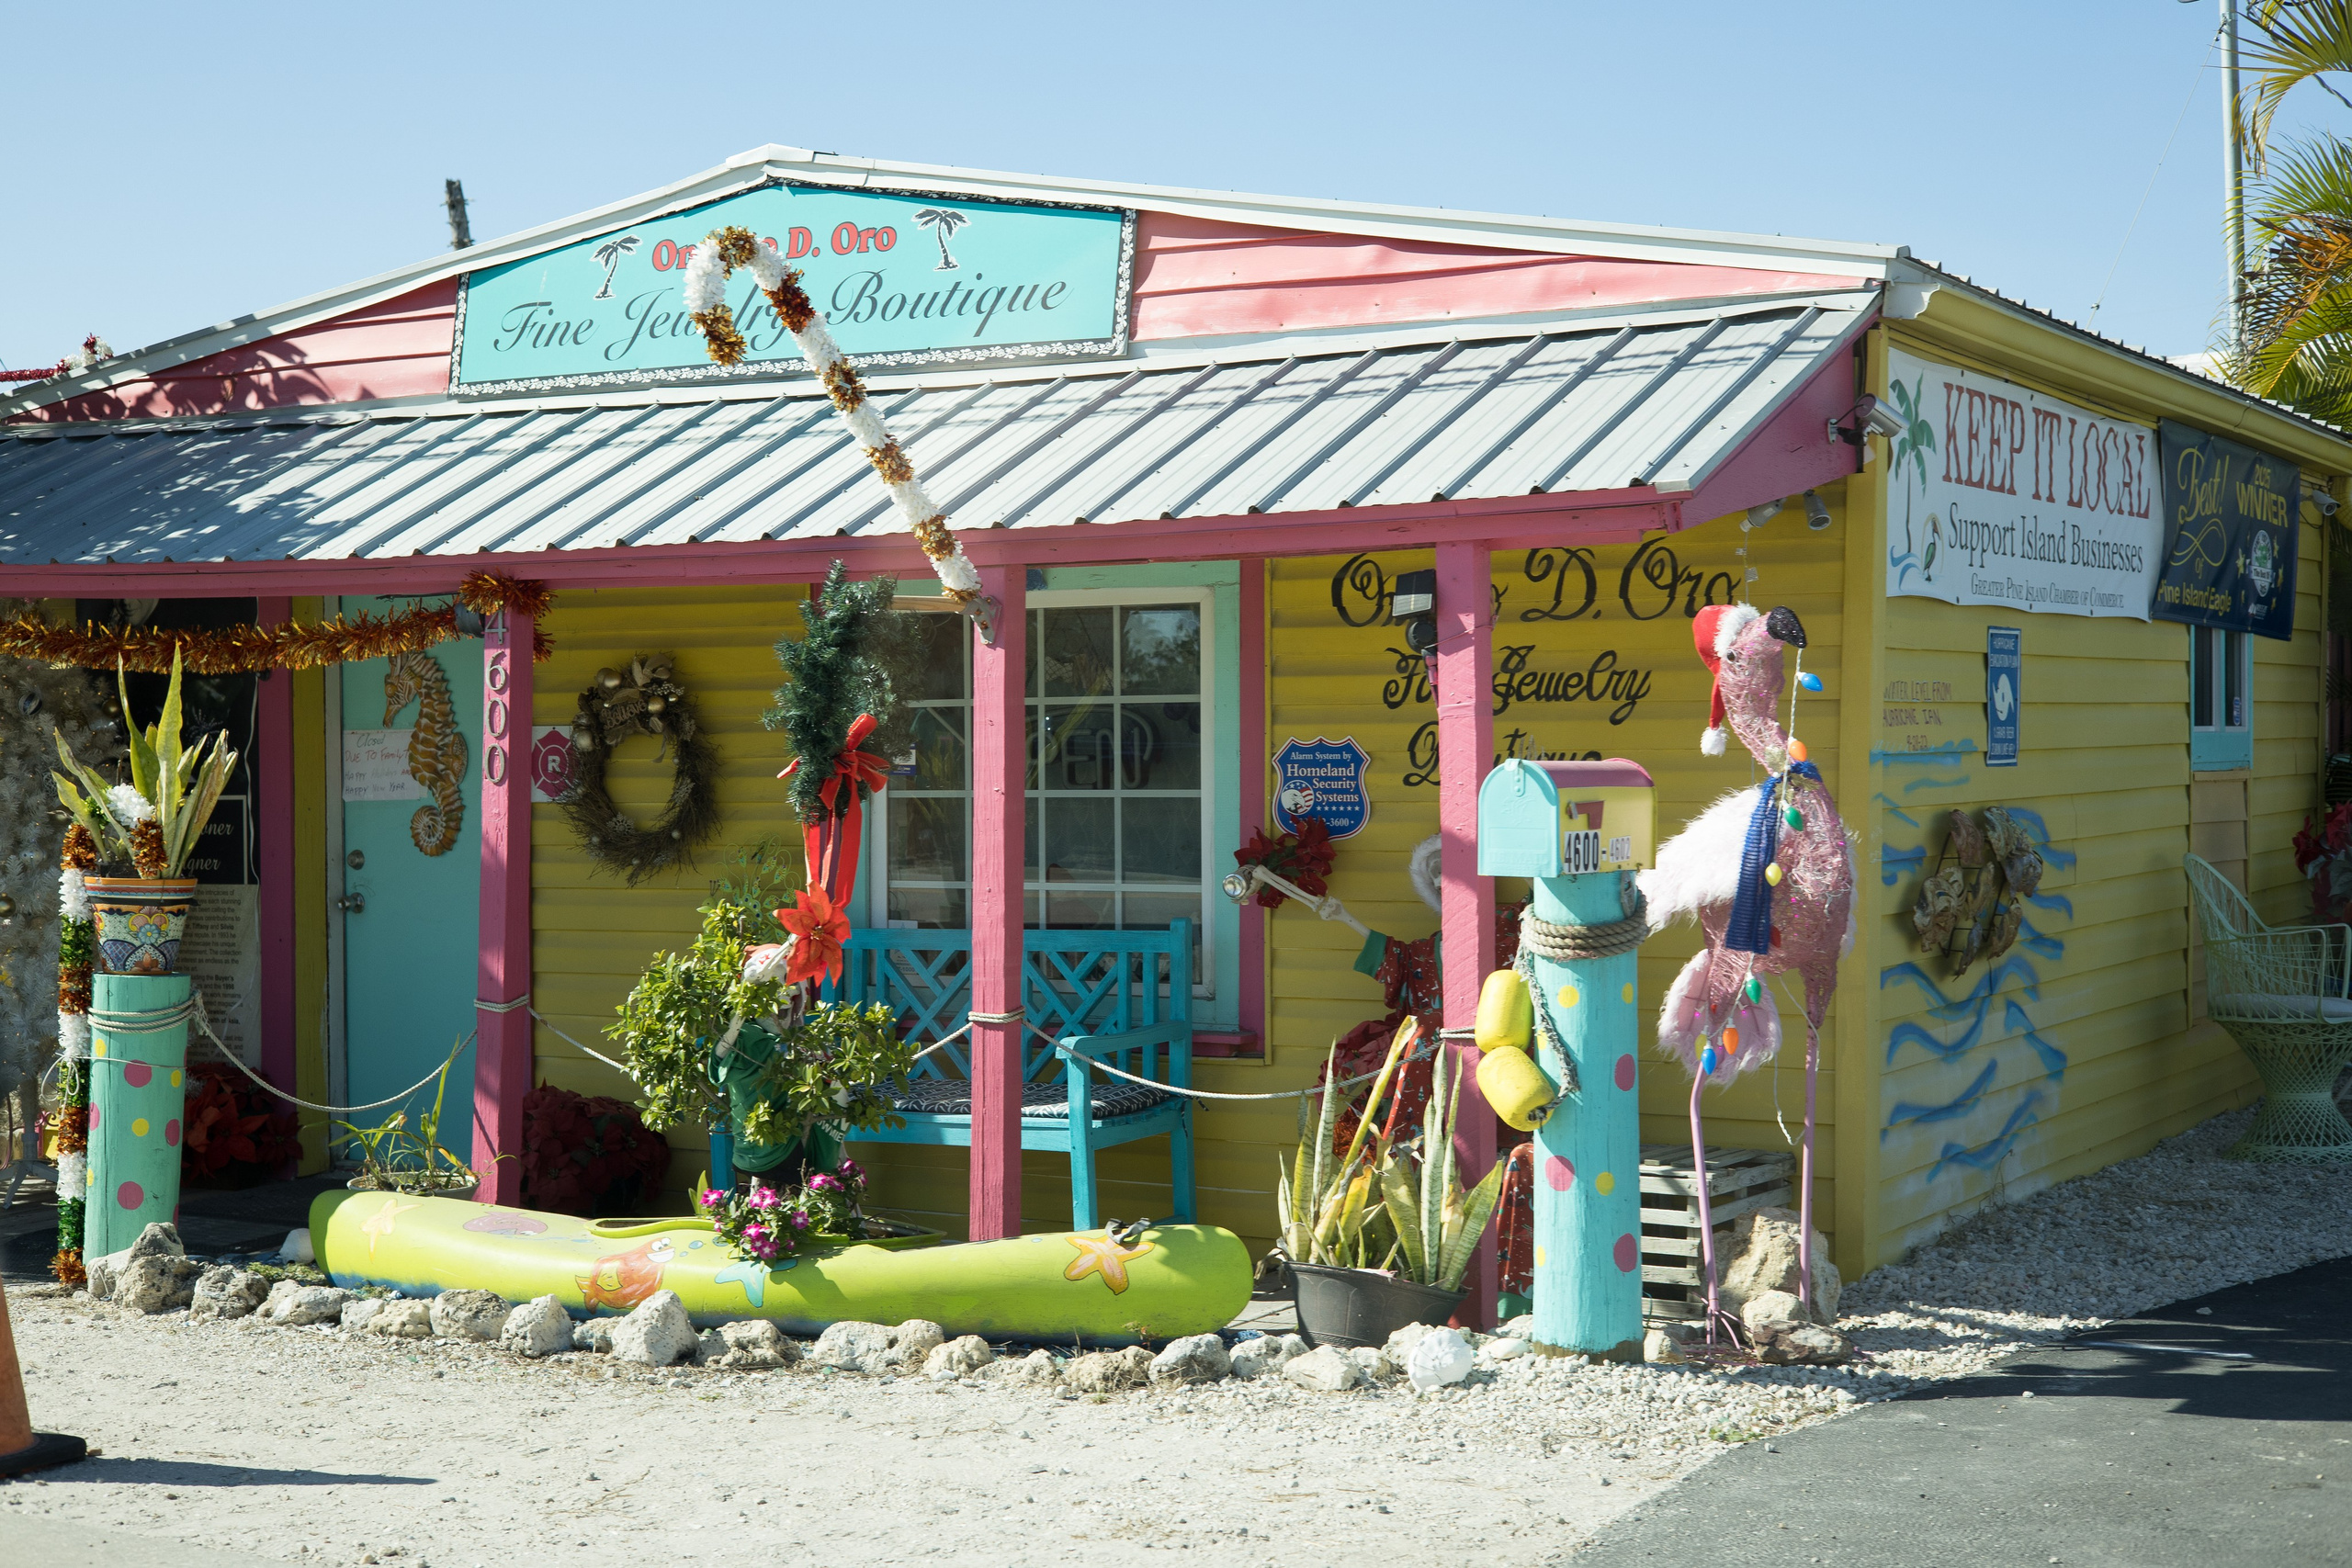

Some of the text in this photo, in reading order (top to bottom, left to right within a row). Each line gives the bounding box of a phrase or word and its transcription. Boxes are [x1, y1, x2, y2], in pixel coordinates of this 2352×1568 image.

[786, 226, 820, 259] D.
[831, 220, 898, 255] Oro
[493, 301, 599, 353] Fine
[825, 268, 1074, 338] Boutique
[1942, 381, 2151, 519] KEEP IT LOCAL
[1949, 502, 2143, 573] Support Island Businesses
[1520, 547, 1602, 622] D.
[1619, 536, 1741, 620] Oro
[1971, 572, 2124, 608] GREATER PINE ISLAND CHAMBER OF COMMERCE
[2157, 579, 2180, 604] Pine
[2182, 582, 2211, 608] Island
[2210, 587, 2232, 616] Eagle
[485, 611, 507, 783] 4600
[1492, 644, 1652, 726] Jewelry
[1911, 681, 1931, 702] LEVEL
[548, 755, 560, 773] R
[1025, 728, 1142, 791] PEN
[1286, 763, 1355, 776] Homeland
[1290, 751, 1352, 761] Alarm System by
[1312, 778, 1357, 792] Security
[1316, 791, 1359, 805] Systems
[1564, 830, 1600, 873] 4600
